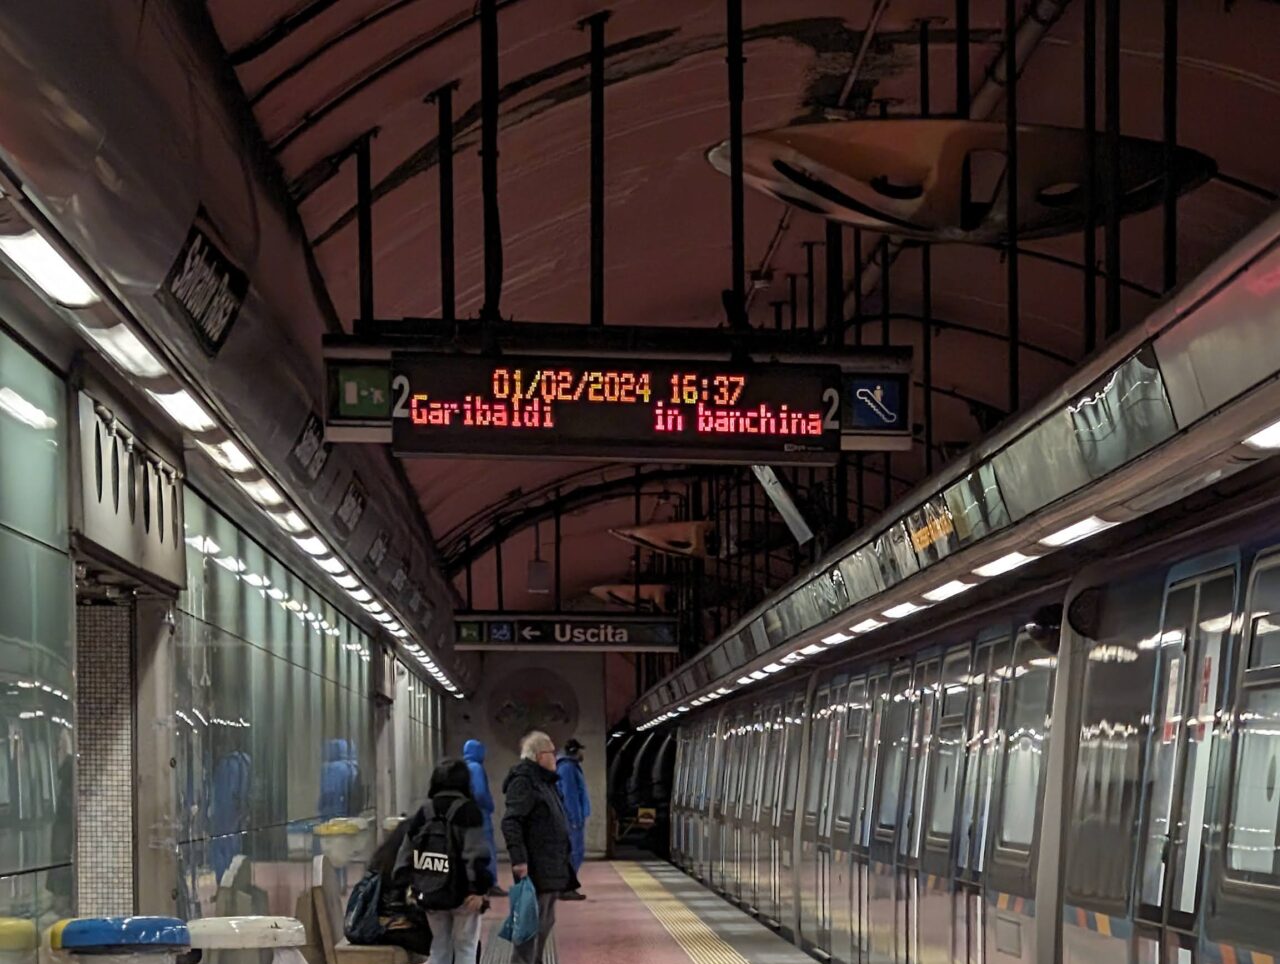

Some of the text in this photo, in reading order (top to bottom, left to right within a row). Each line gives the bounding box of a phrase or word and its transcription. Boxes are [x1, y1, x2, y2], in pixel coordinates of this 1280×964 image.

[392, 374, 410, 417] 2
[494, 369, 745, 405] 01/02/2024 16:37
[411, 395, 822, 435] Garibaldi in banchina
[822, 388, 839, 429] 2
[554, 623, 629, 643] Uscita
